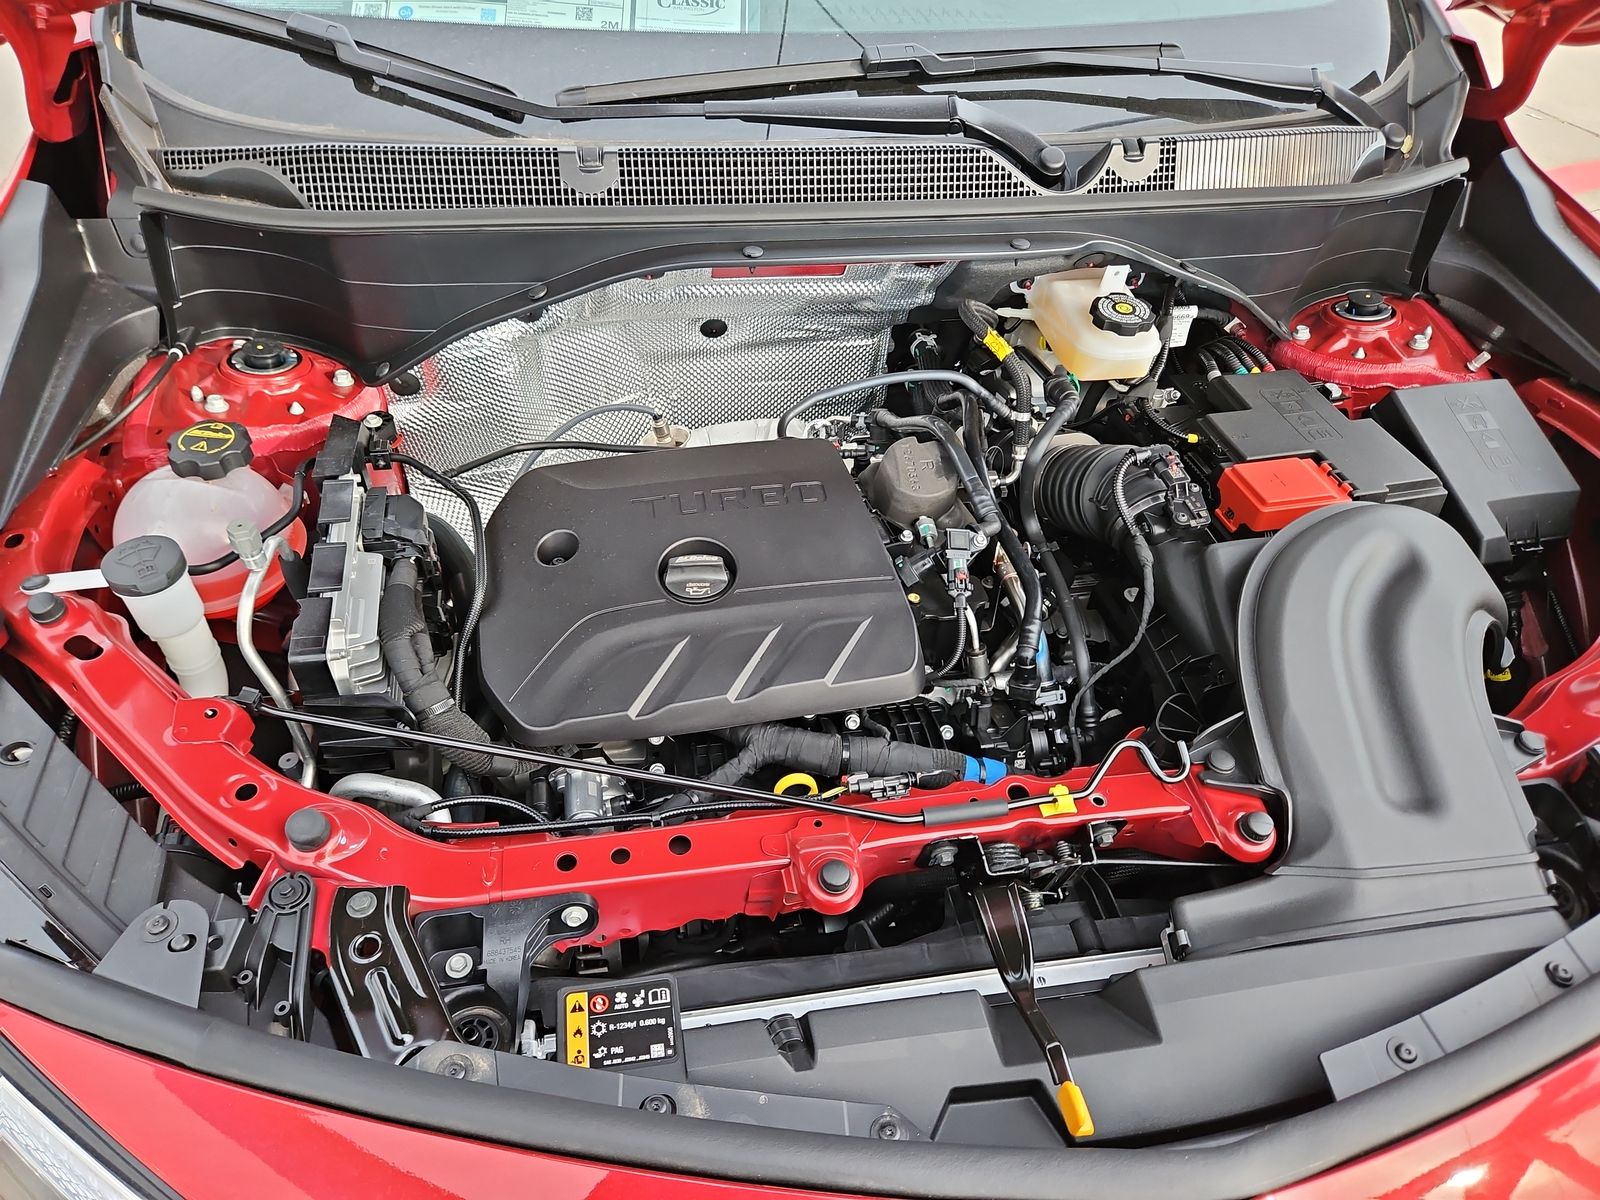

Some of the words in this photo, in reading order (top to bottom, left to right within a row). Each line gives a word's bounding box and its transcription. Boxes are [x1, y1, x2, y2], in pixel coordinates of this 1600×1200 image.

[657, 0, 725, 9] CLASSIC
[600, 20, 619, 30] 2M
[630, 480, 828, 519] TURBO
[1017, 750, 1026, 758] R
[609, 1021, 637, 1031] R-1234yf
[657, 1017, 666, 1025] kg
[610, 1045, 624, 1055] PAG
